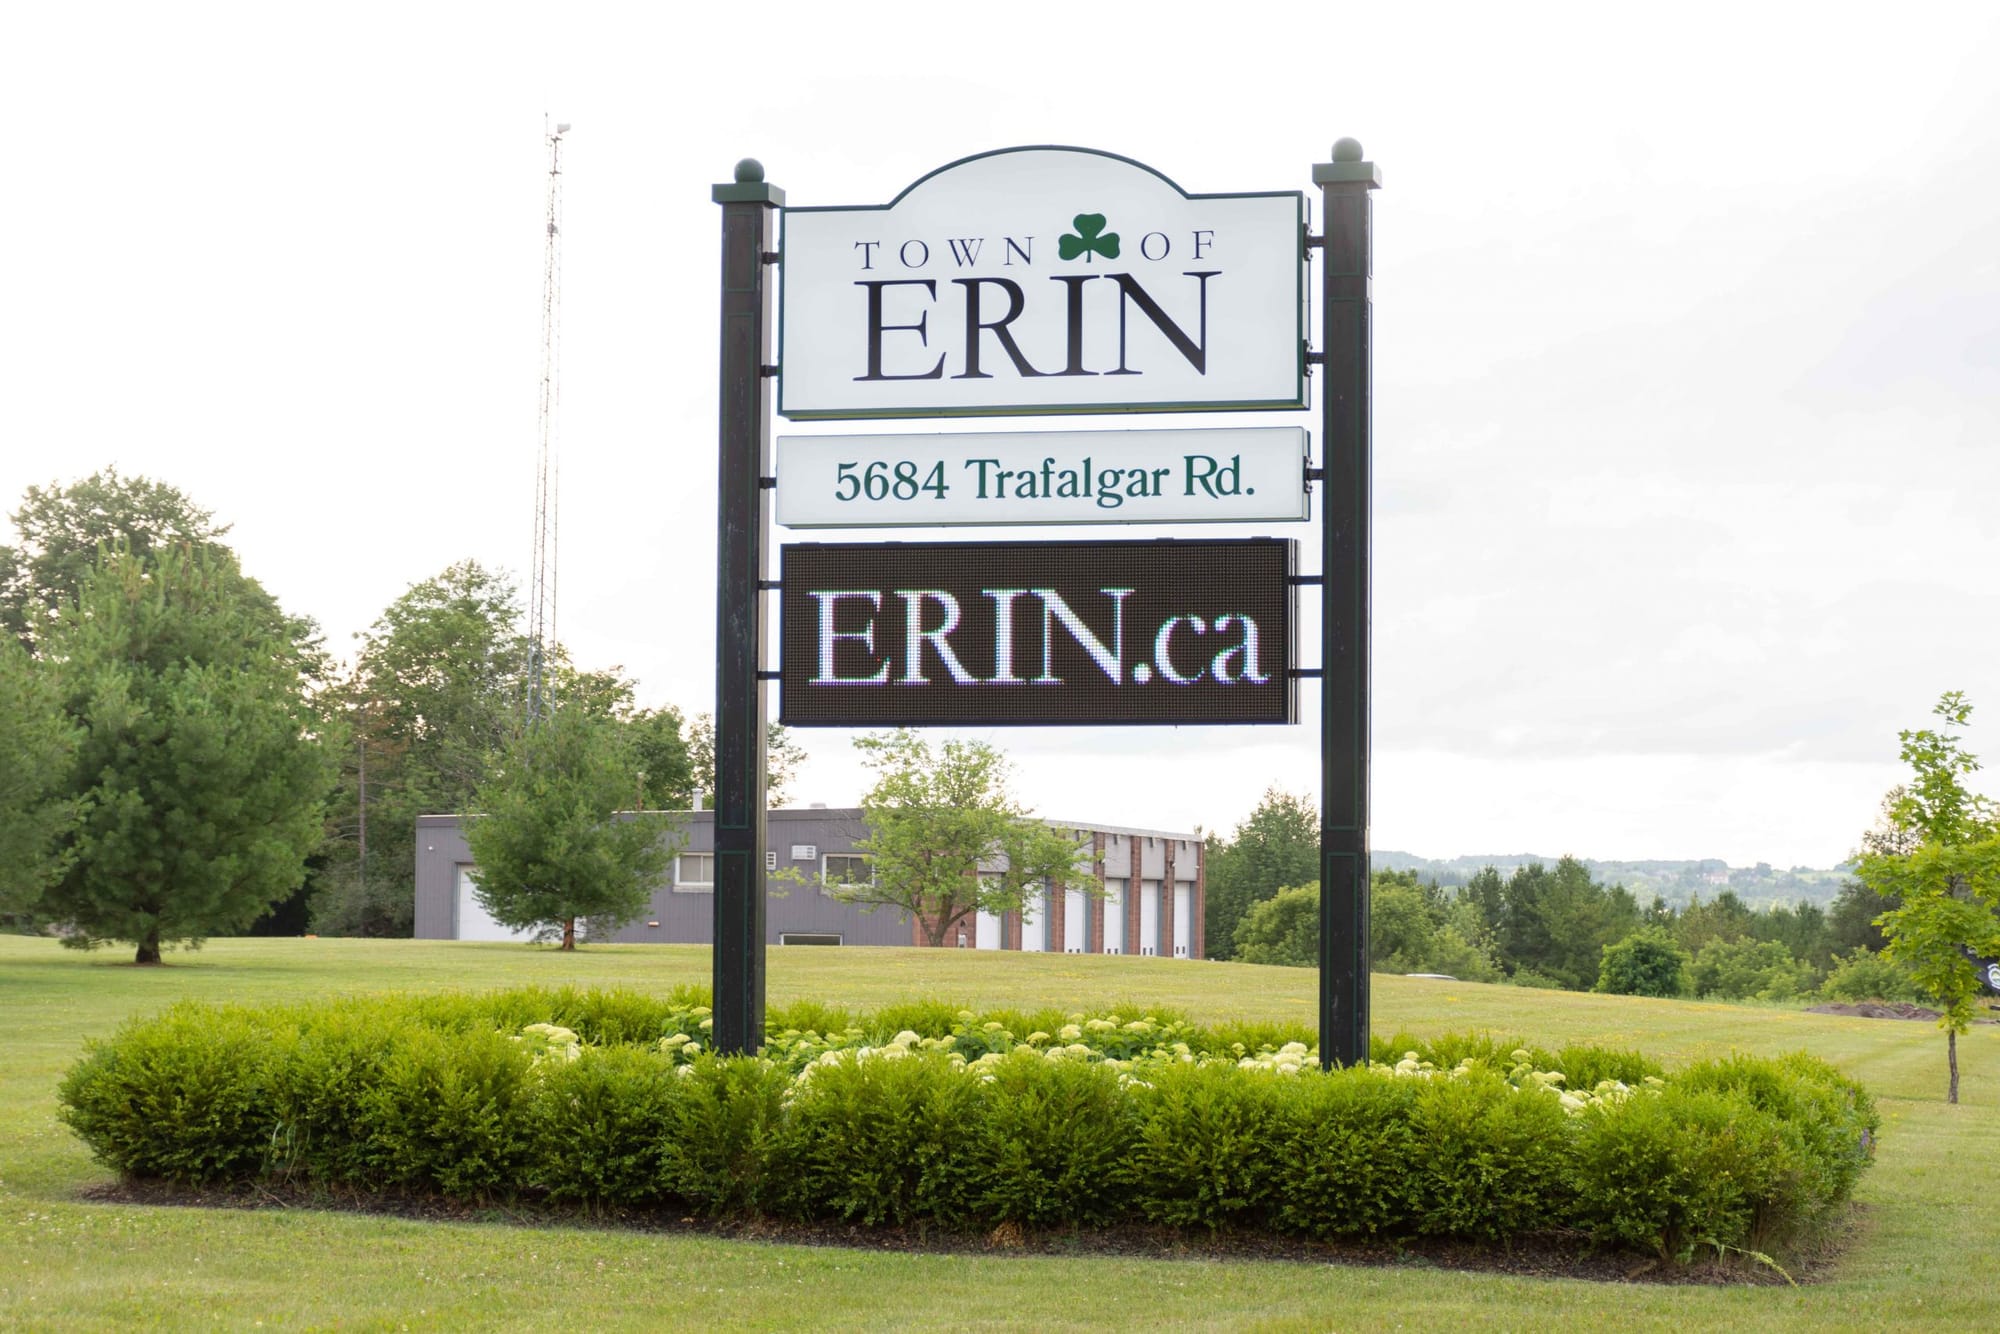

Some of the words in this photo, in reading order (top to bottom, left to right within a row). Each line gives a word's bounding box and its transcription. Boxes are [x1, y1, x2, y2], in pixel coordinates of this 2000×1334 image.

[854, 236, 1034, 269] TOWN
[1140, 230, 1215, 261] OF
[852, 271, 1222, 382] ERIN
[835, 460, 949, 501] 5684
[965, 456, 1170, 508] Trafalgar
[1183, 454, 1256, 500] Rd.
[807, 588, 1270, 686] ERIN.ca
